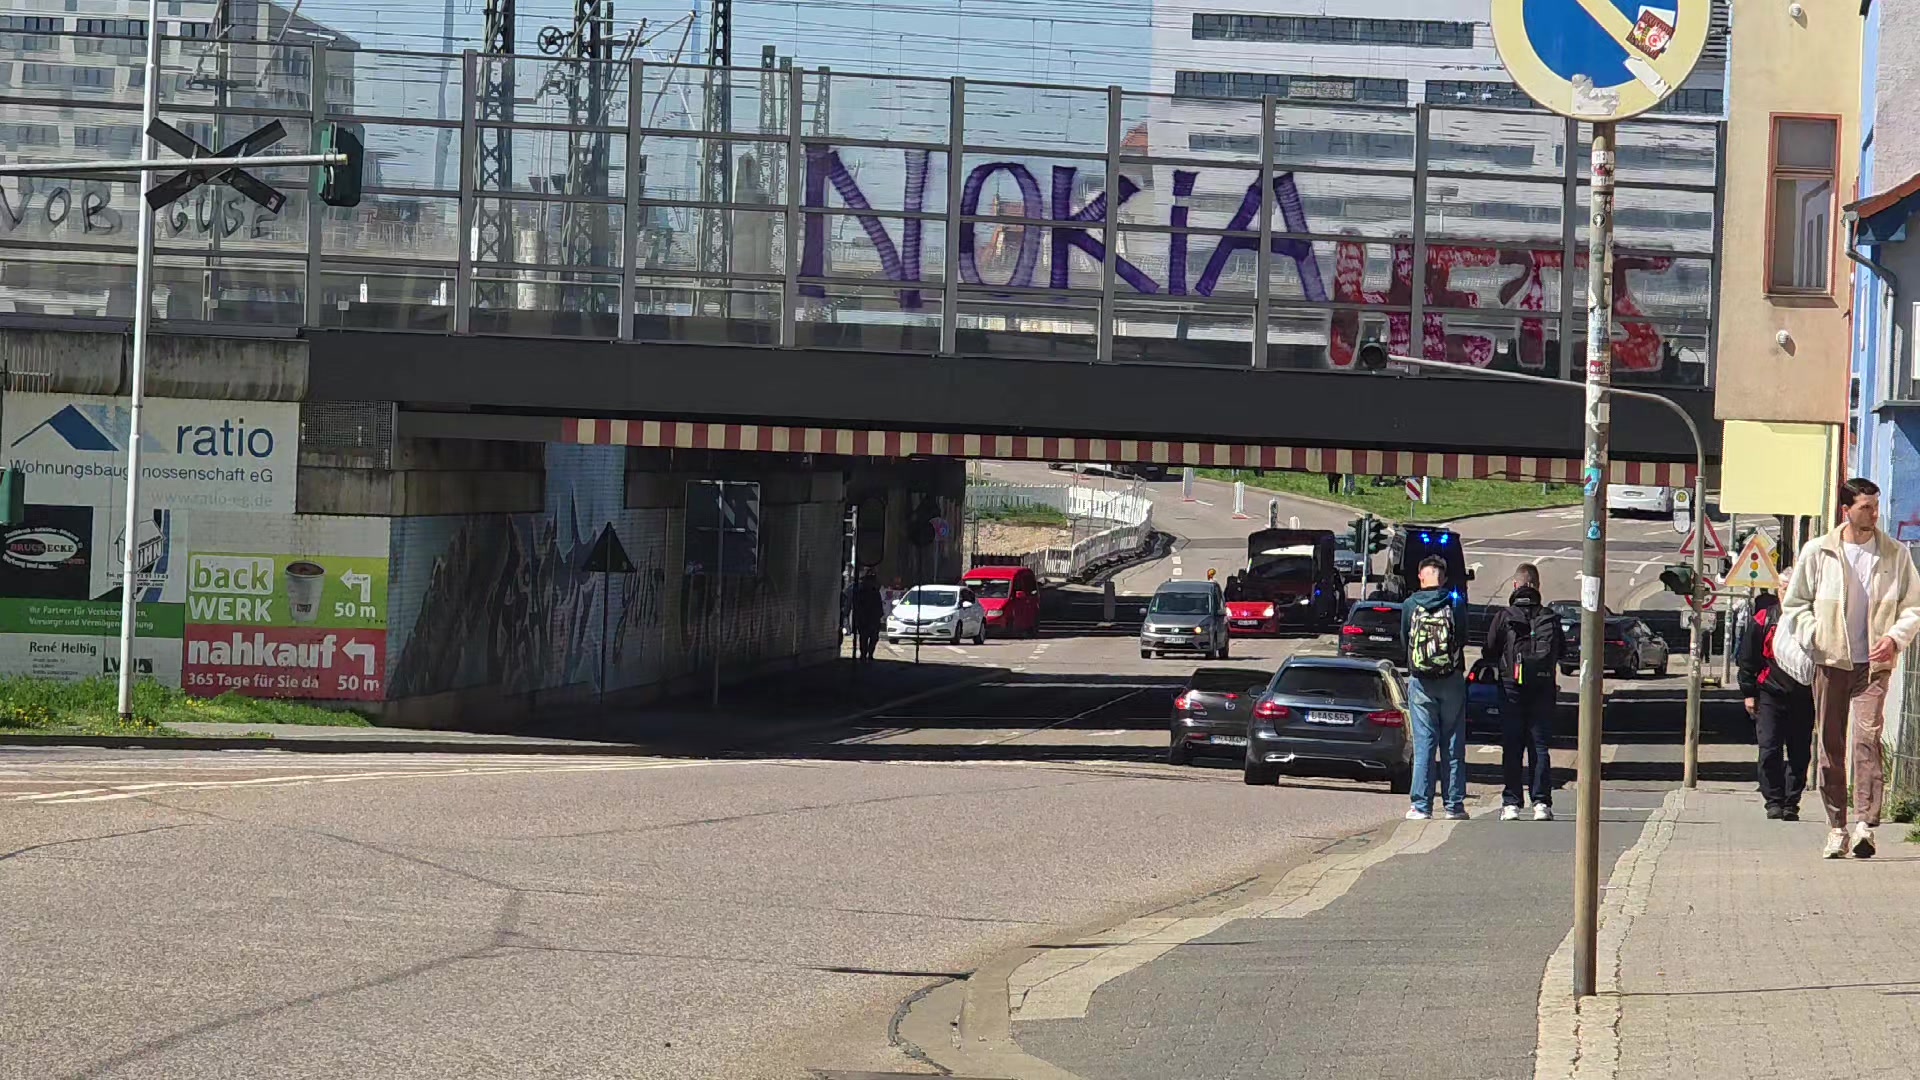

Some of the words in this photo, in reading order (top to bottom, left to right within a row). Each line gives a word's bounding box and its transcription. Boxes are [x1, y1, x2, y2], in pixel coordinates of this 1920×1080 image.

[176, 418, 273, 458] ratio
[10, 459, 245, 482] Wohnungsbaugnossenschaft
[250, 468, 273, 482] eG
[194, 559, 270, 591] back
[43, 605, 71, 614] Partner
[73, 606, 85, 616] für
[188, 595, 273, 622] WERK
[334, 602, 356, 617] 50
[359, 605, 376, 618] m
[65, 618, 79, 626] und
[29, 641, 57, 652] René
[61, 642, 97, 656] Helbig
[188, 632, 337, 668] nahkauf
[187, 673, 214, 685] 365
[217, 673, 250, 689] Tage
[253, 674, 275, 688] für
[277, 674, 300, 688] Sie
[302, 675, 319, 688] da
[337, 675, 359, 690] 50
[364, 678, 380, 691] m
